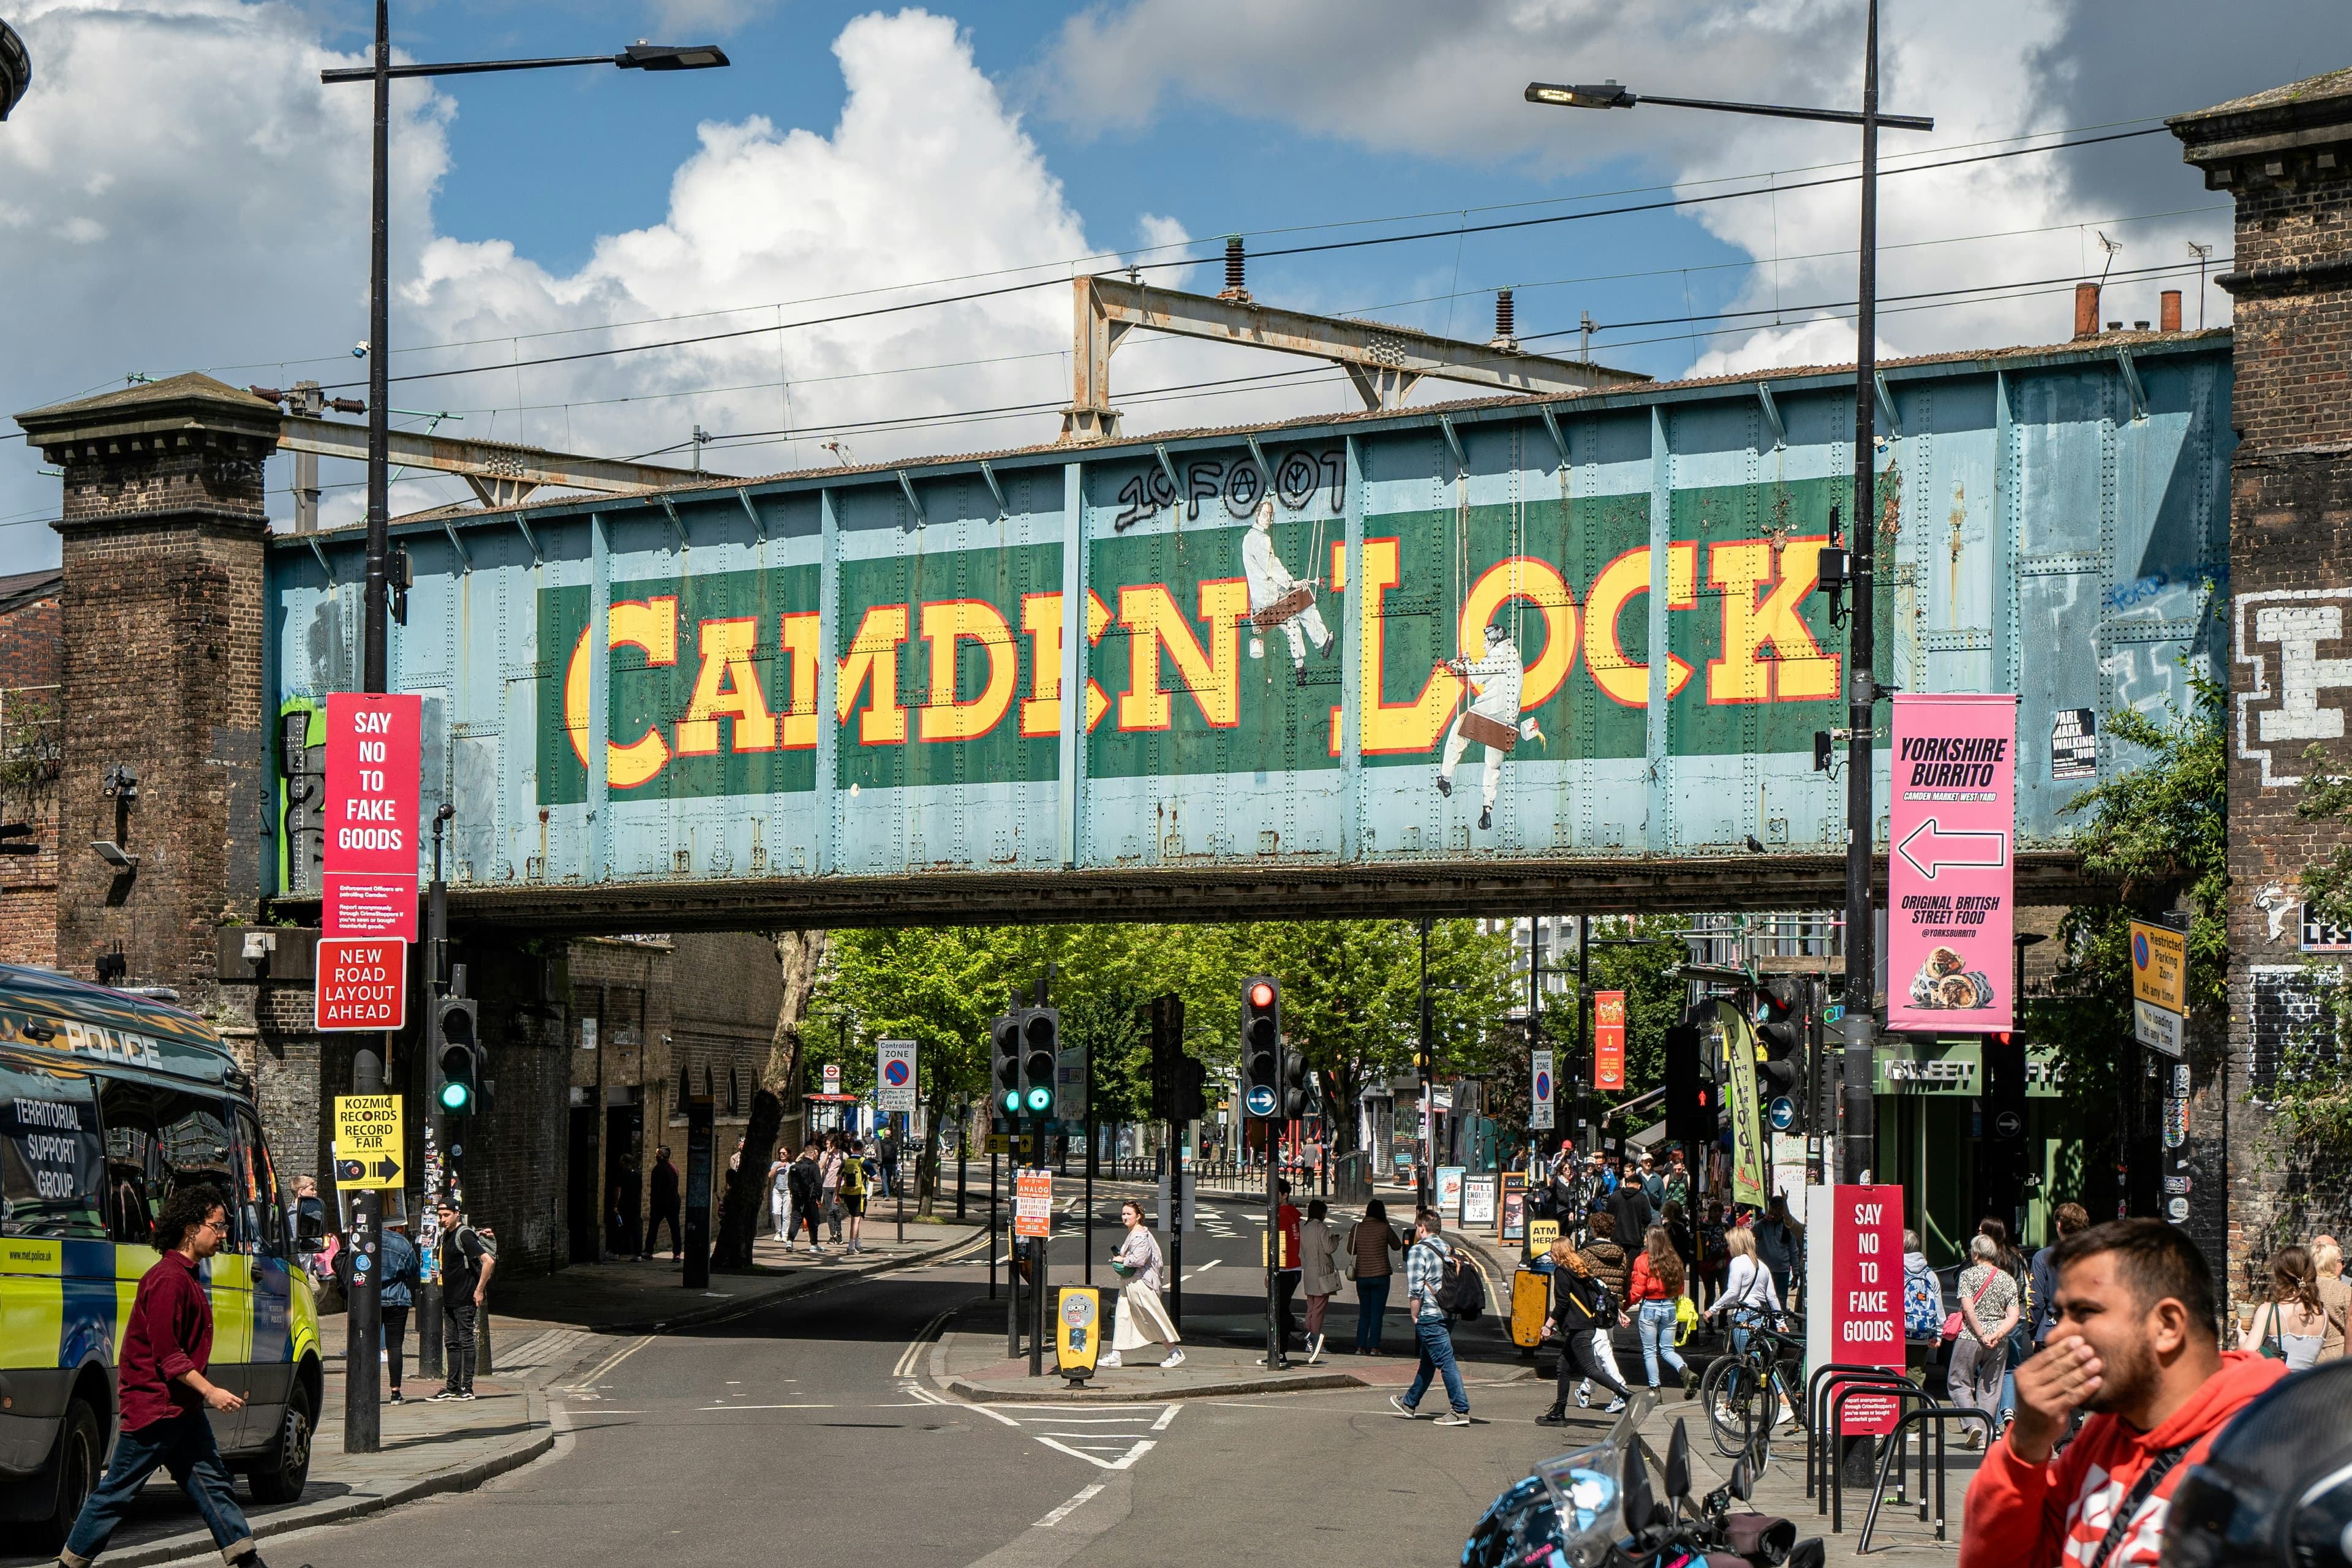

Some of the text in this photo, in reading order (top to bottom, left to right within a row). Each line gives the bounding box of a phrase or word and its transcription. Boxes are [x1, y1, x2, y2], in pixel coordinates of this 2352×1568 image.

[564, 533, 1844, 790] CAMDEN LOCK
[354, 712, 392, 733] SAY
[359, 741, 385, 763] NO
[1901, 737, 2008, 762] YORKSHIRE
[2052, 735, 2095, 750] WALKING
[2073, 747, 2095, 760] TOUR
[359, 769, 384, 791] TO
[1910, 763, 1994, 787] BURRITO
[1904, 791, 1997, 801] CAMDEN MARKET WEST YARD
[346, 799, 396, 821] FAKE
[338, 828, 402, 850] GOODS
[1901, 895, 2000, 910] ORIGINAL BRITISH
[1912, 910, 1986, 924] STREET FOOD
[1921, 929, 1977, 938] @YORKSBURRITO
[2150, 932, 2182, 952] Restricted
[340, 949, 382, 964] NEW
[2155, 949, 2177, 969] Parking
[334, 967, 385, 982] ROAD
[2159, 966, 2173, 981] Zone
[325, 985, 395, 1001] LAYOUT
[2143, 981, 2174, 1003] At any time
[326, 1004, 390, 1020] AHEAD
[2144, 1008, 2152, 1022] No
[2153, 1012, 2173, 1032] loading
[64, 1019, 163, 1070] POLICE
[2144, 1026, 2173, 1046] at any time
[345, 1098, 392, 1109] KOZMIC
[13, 1097, 82, 1131] TERRITORIAL
[341, 1110, 397, 1122] RECORDS
[345, 1124, 393, 1136] RECORD
[28, 1133, 75, 1164] SUPPORT
[356, 1137, 382, 1148] FAIR
[37, 1170, 74, 1198] GROUP
[1019, 1185, 1049, 1194] ANALOG
[1854, 1204, 1883, 1225] SAY
[1533, 1227, 1556, 1235] ATM
[1858, 1232, 1879, 1254] NO
[9, 1250, 52, 1263] www.met.police.uk
[1858, 1262, 1878, 1284] TO
[1849, 1291, 1888, 1313] FAKE
[1843, 1321, 1893, 1342] GOODS
[2105, 1493, 2139, 1548] MAX
